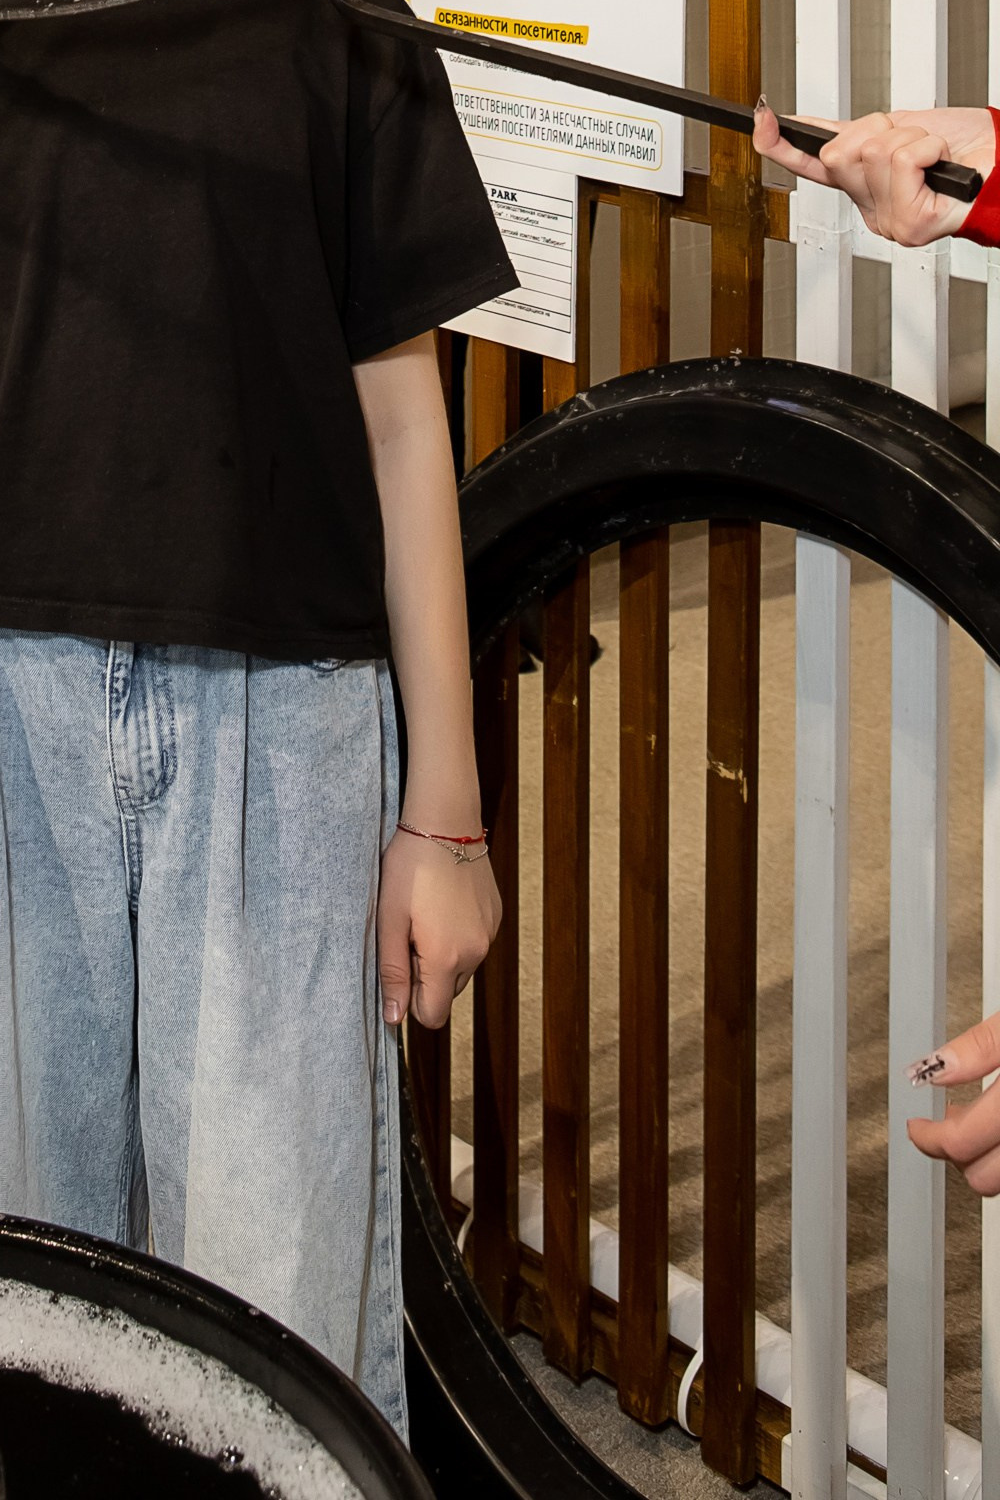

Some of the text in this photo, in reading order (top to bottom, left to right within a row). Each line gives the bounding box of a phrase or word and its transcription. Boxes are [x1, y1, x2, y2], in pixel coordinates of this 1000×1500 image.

[454, 93, 657, 145] ОТВЕТСТВЕННОСТИ ЗА НЕСЧАСТНЫЕ СЛУЧАИ,
[502, 120, 574, 147] ПОСЕТИТЕЛЯМИ
[576, 135, 615, 155] ДАННЫХ
[618, 143, 656, 162] ПРАВИЛ
[491, 188, 518, 202] PARK
